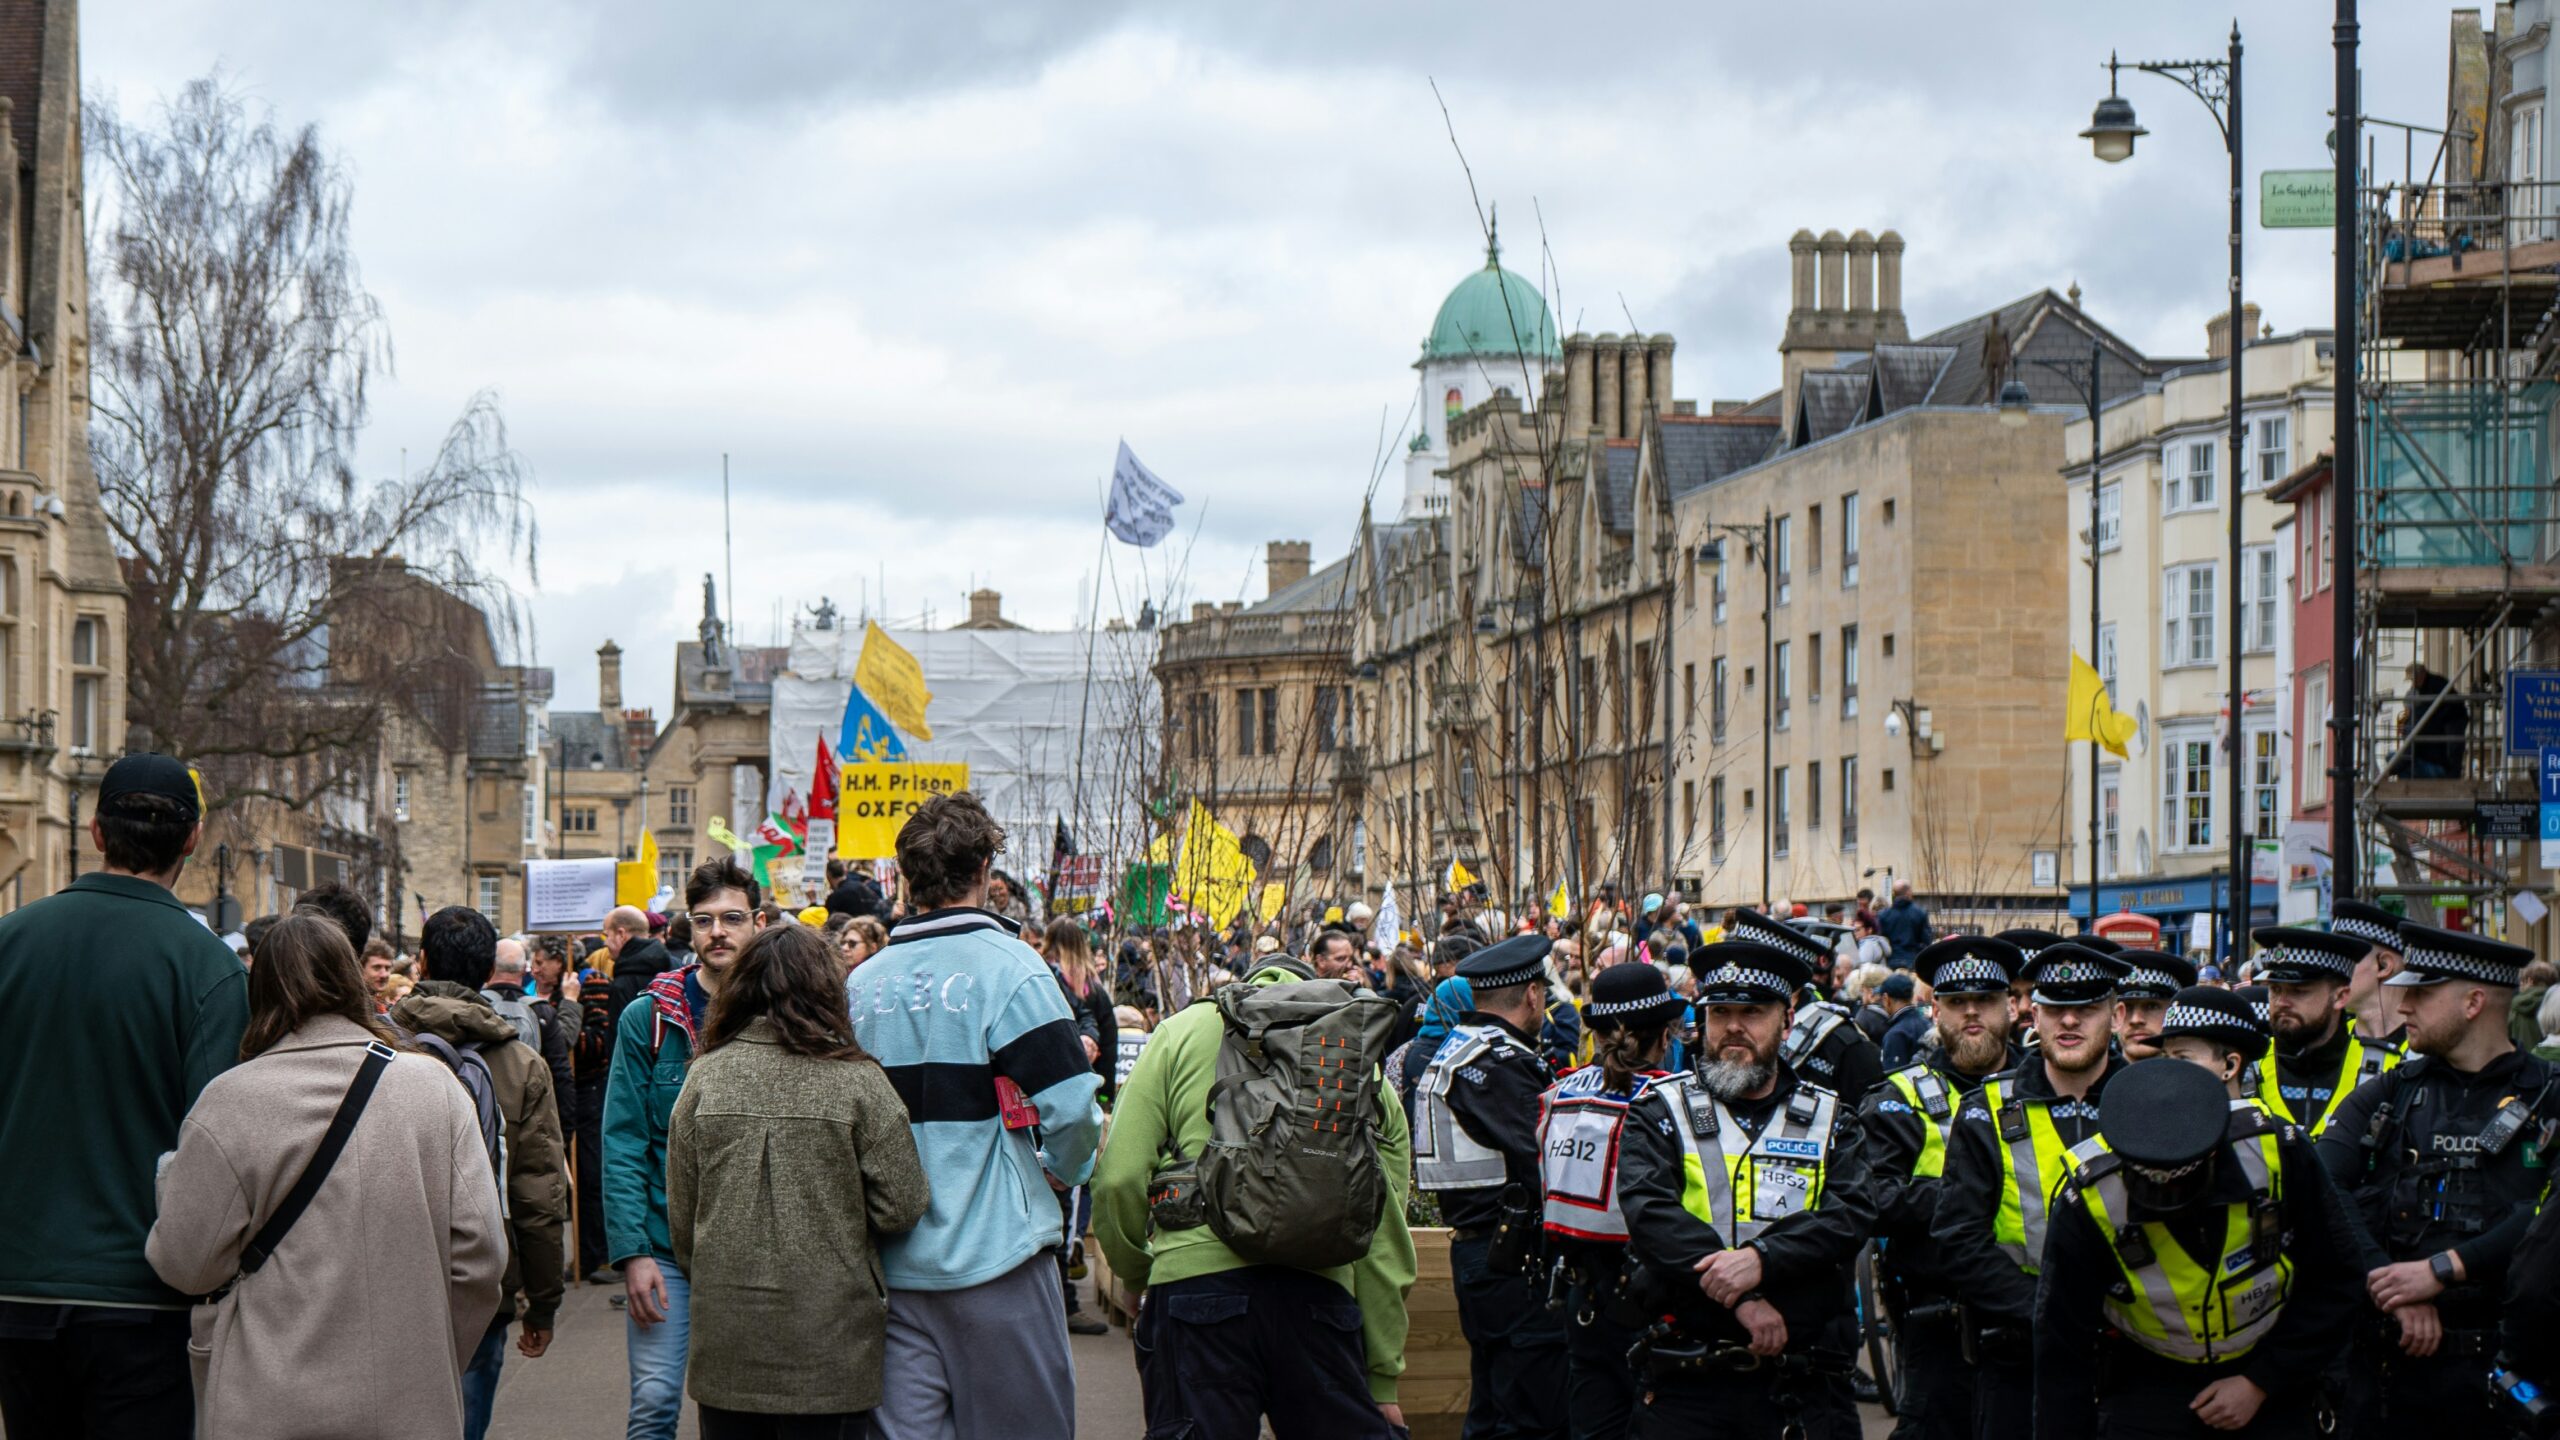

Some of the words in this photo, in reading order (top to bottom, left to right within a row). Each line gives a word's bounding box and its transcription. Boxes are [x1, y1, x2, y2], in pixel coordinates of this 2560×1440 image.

[846, 774, 882, 791] H.M.
[889, 774, 952, 791] Prison
[1767, 1141, 1817, 1154] POLICE
[1775, 1195, 1788, 1209] A
[2240, 1282, 2272, 1305] HB2
